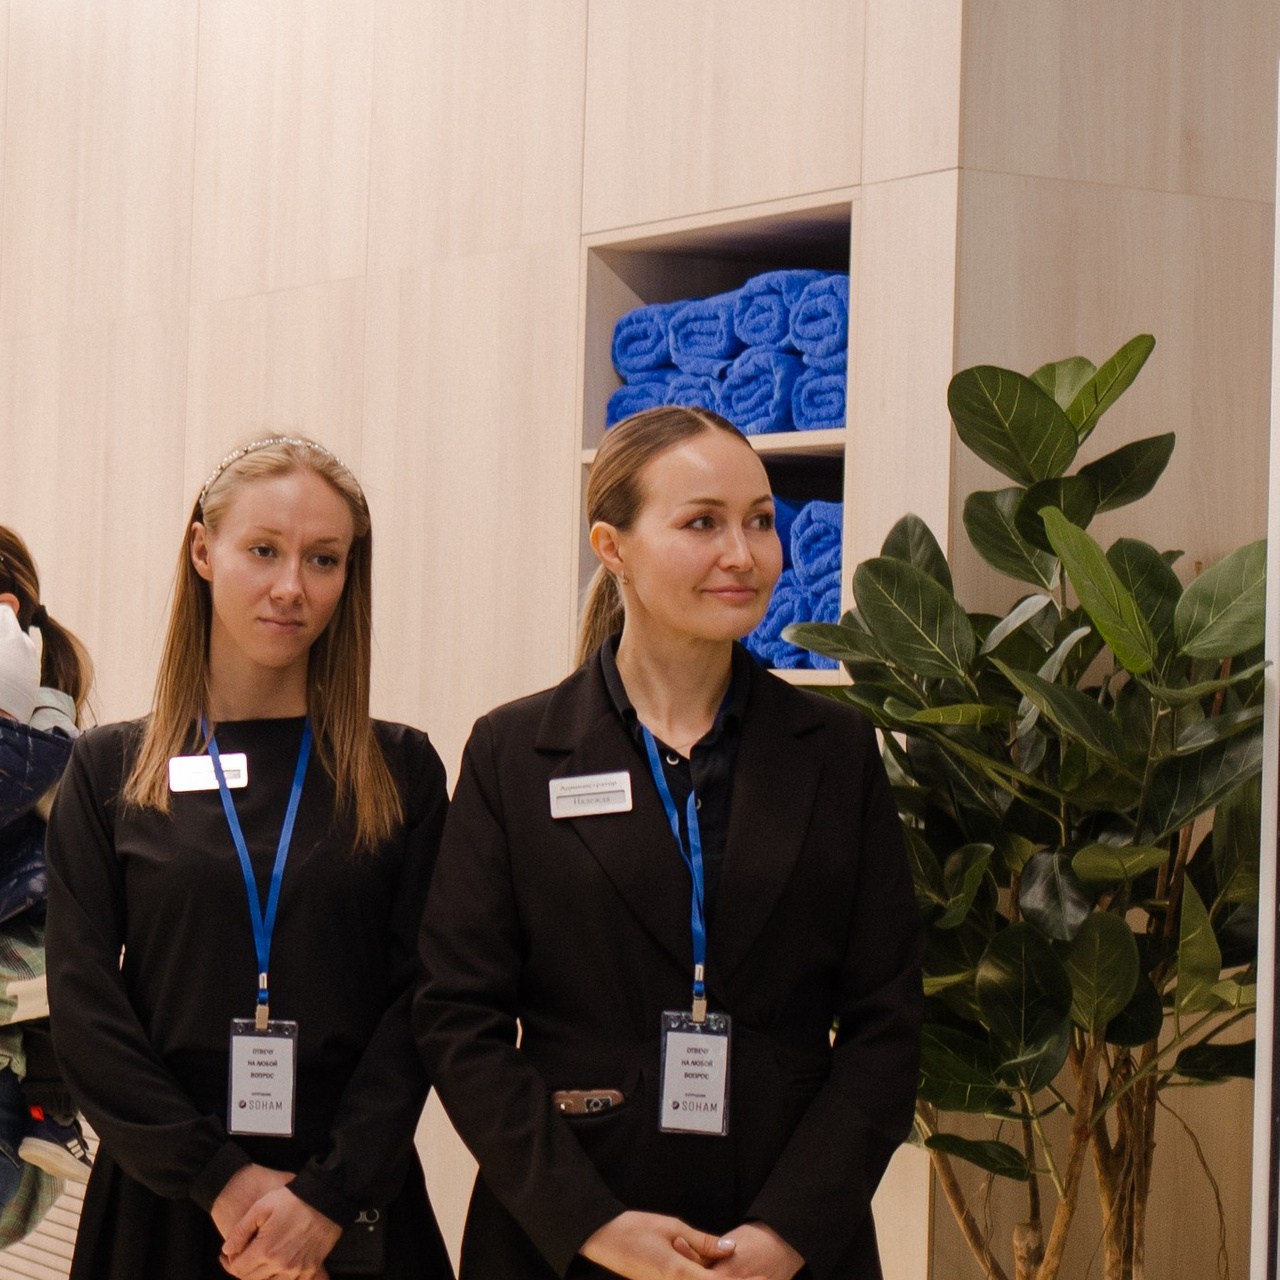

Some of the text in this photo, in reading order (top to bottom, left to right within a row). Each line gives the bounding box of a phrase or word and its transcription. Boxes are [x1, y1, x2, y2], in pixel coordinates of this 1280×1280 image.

[257, 1059, 278, 1067] ЛЮБОЙ
[690, 1059, 713, 1068] ЛЮБОЙ
[684, 1072, 709, 1080] ВОПРОС
[248, 1100, 283, 1111] SOHAM
[682, 1100, 718, 1113] SOHAM
